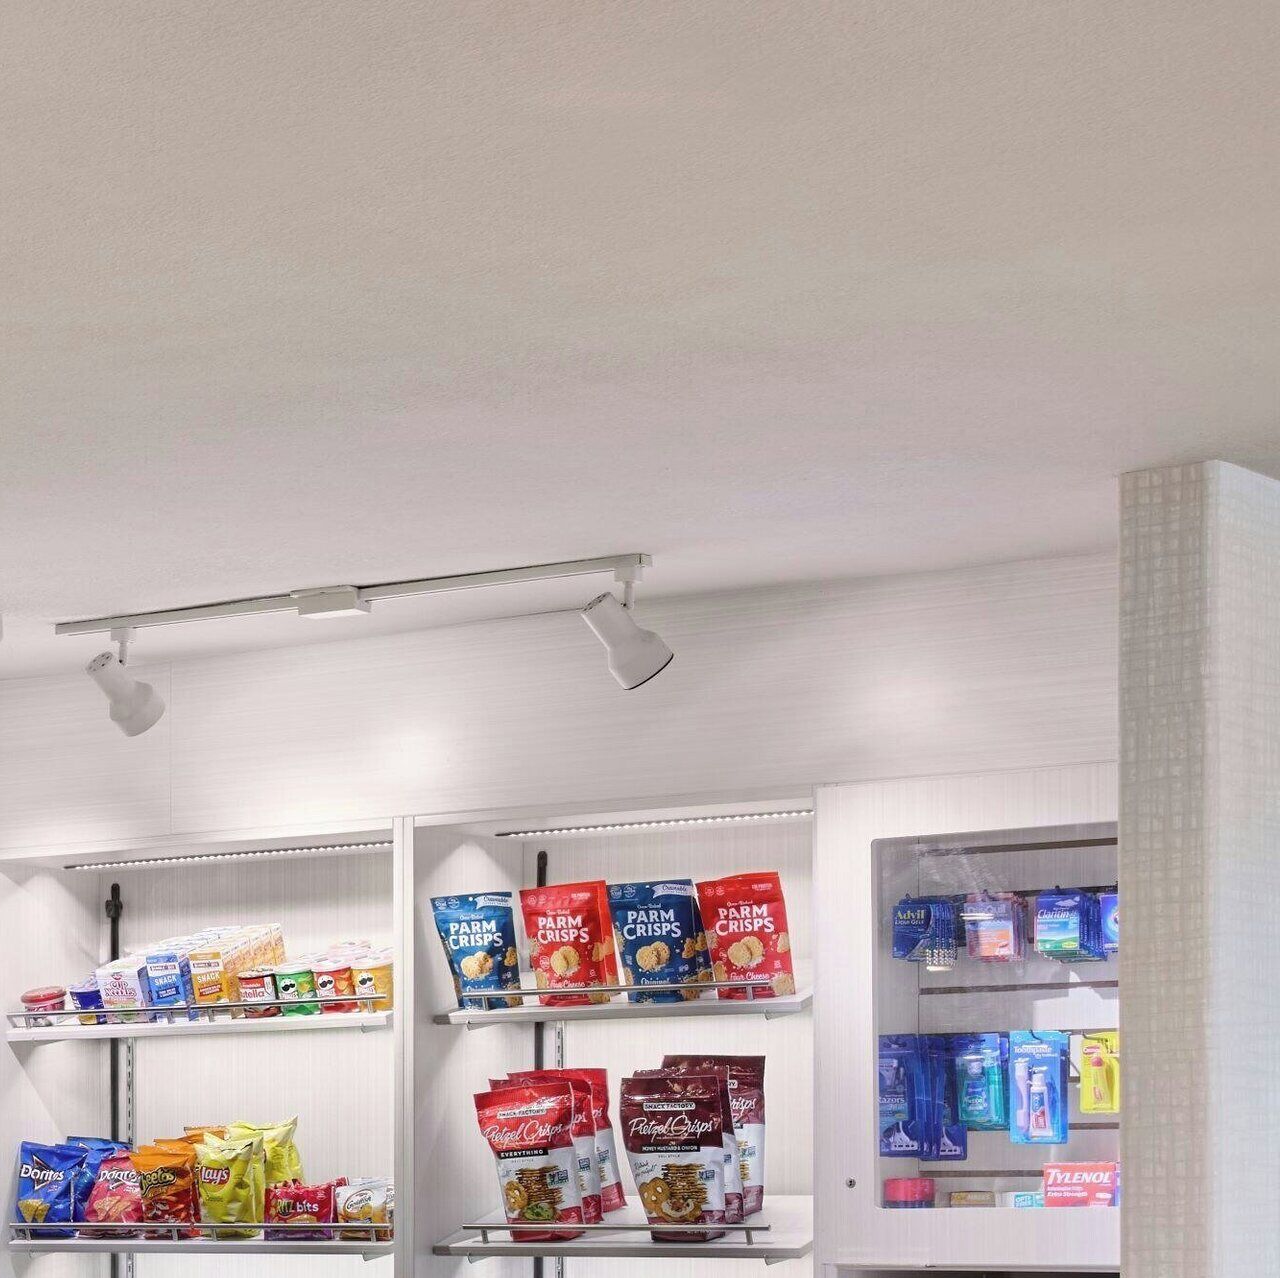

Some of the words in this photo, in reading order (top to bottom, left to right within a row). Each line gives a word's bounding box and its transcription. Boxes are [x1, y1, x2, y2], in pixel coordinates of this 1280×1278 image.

[627, 909, 674, 923] PARM
[718, 903, 768, 920] PARM
[449, 919, 497, 935] PARM
[537, 915, 582, 930] PARM
[623, 921, 682, 940] CRISPS
[715, 917, 775, 937] CRISPS
[449, 932, 504, 951] CRISPS
[537, 927, 590, 945] CRISPS
[731, 1097, 756, 1117] risps
[484, 1124, 522, 1148] Pretzel
[524, 1119, 563, 1144] Crisps
[628, 1116, 673, 1143] Pretzel
[671, 1114, 713, 1140] Crisps
[500, 1149, 544, 1158] EVERYTHING
[20, 1164, 65, 1182] Doritos
[140, 1166, 177, 1189] heetos
[200, 1166, 229, 1183] Lay's
[1046, 1169, 1112, 1185] TYLENOL
[296, 1200, 319, 1212] bits
